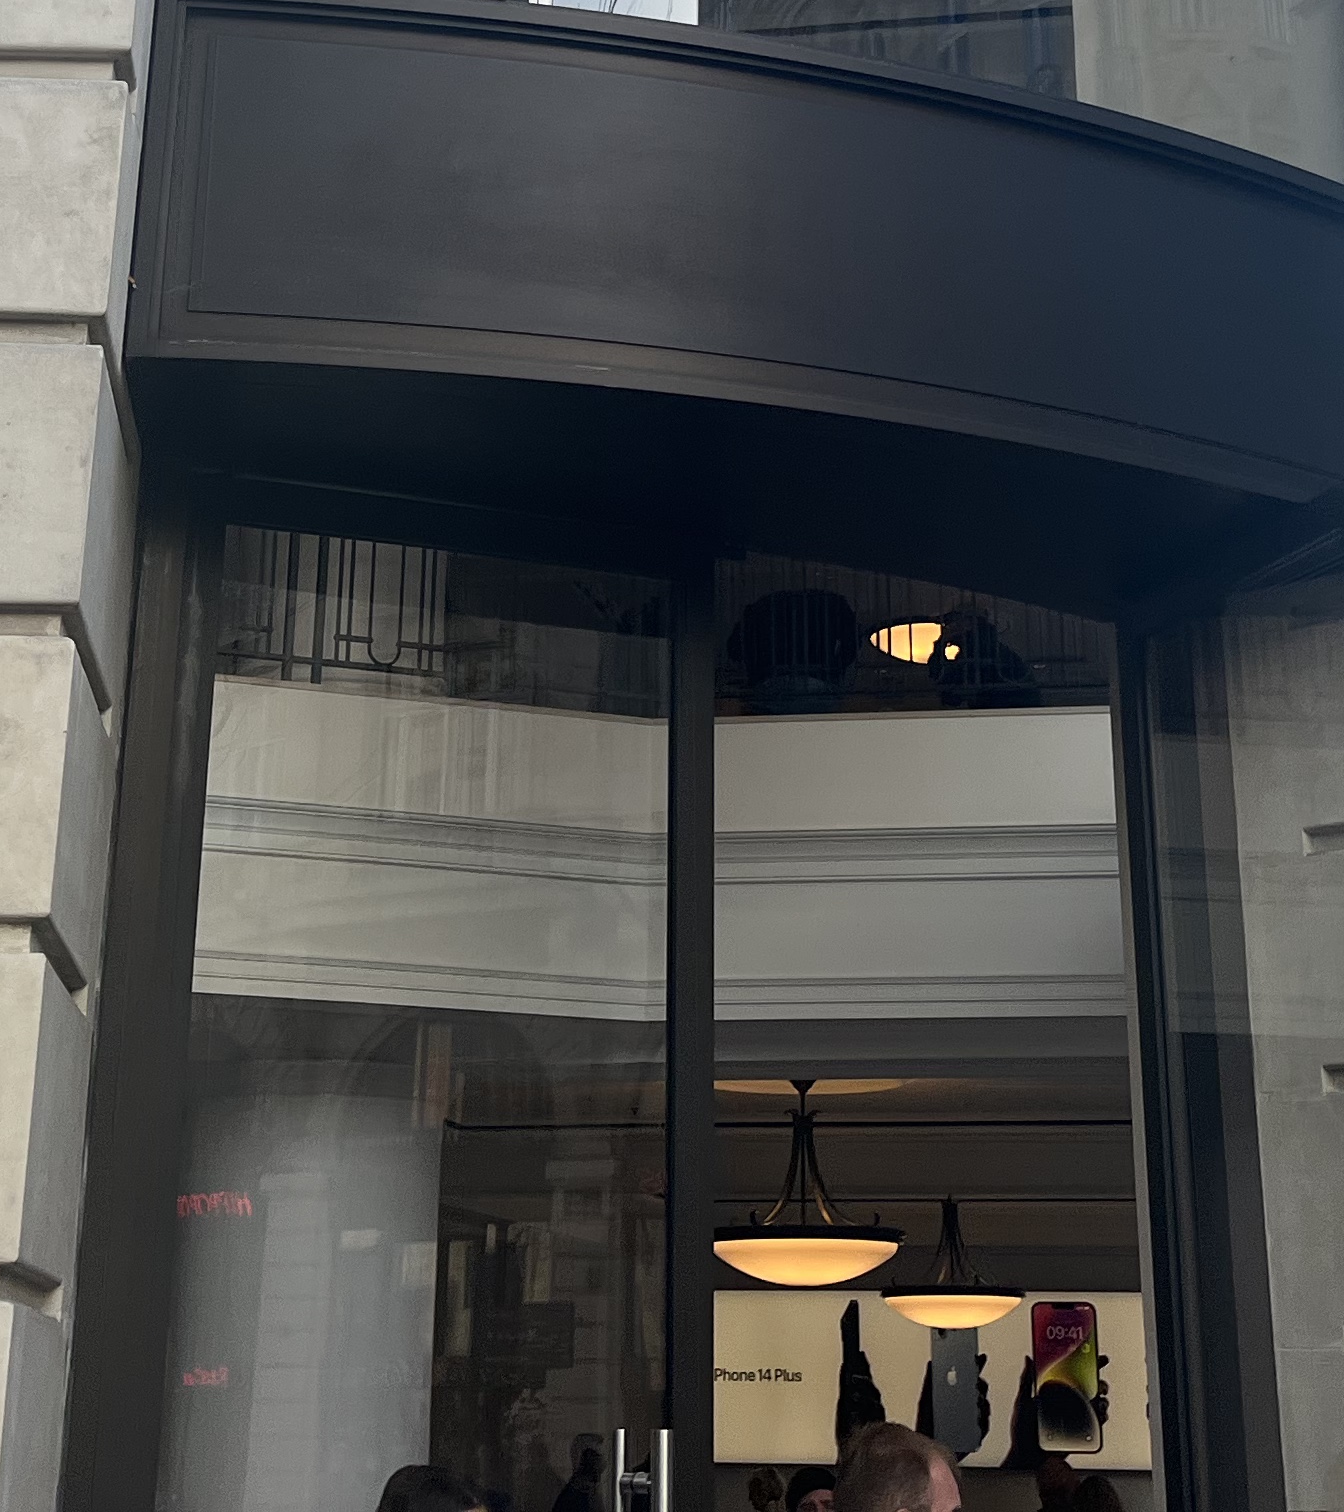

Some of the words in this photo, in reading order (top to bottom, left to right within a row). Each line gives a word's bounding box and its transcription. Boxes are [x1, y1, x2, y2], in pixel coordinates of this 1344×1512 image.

[1046, 1325, 1084, 1340] 09:41
[713, 1367, 756, 1382] Phone
[757, 1368, 772, 1382] 14
[774, 1368, 803, 1382] Plus
